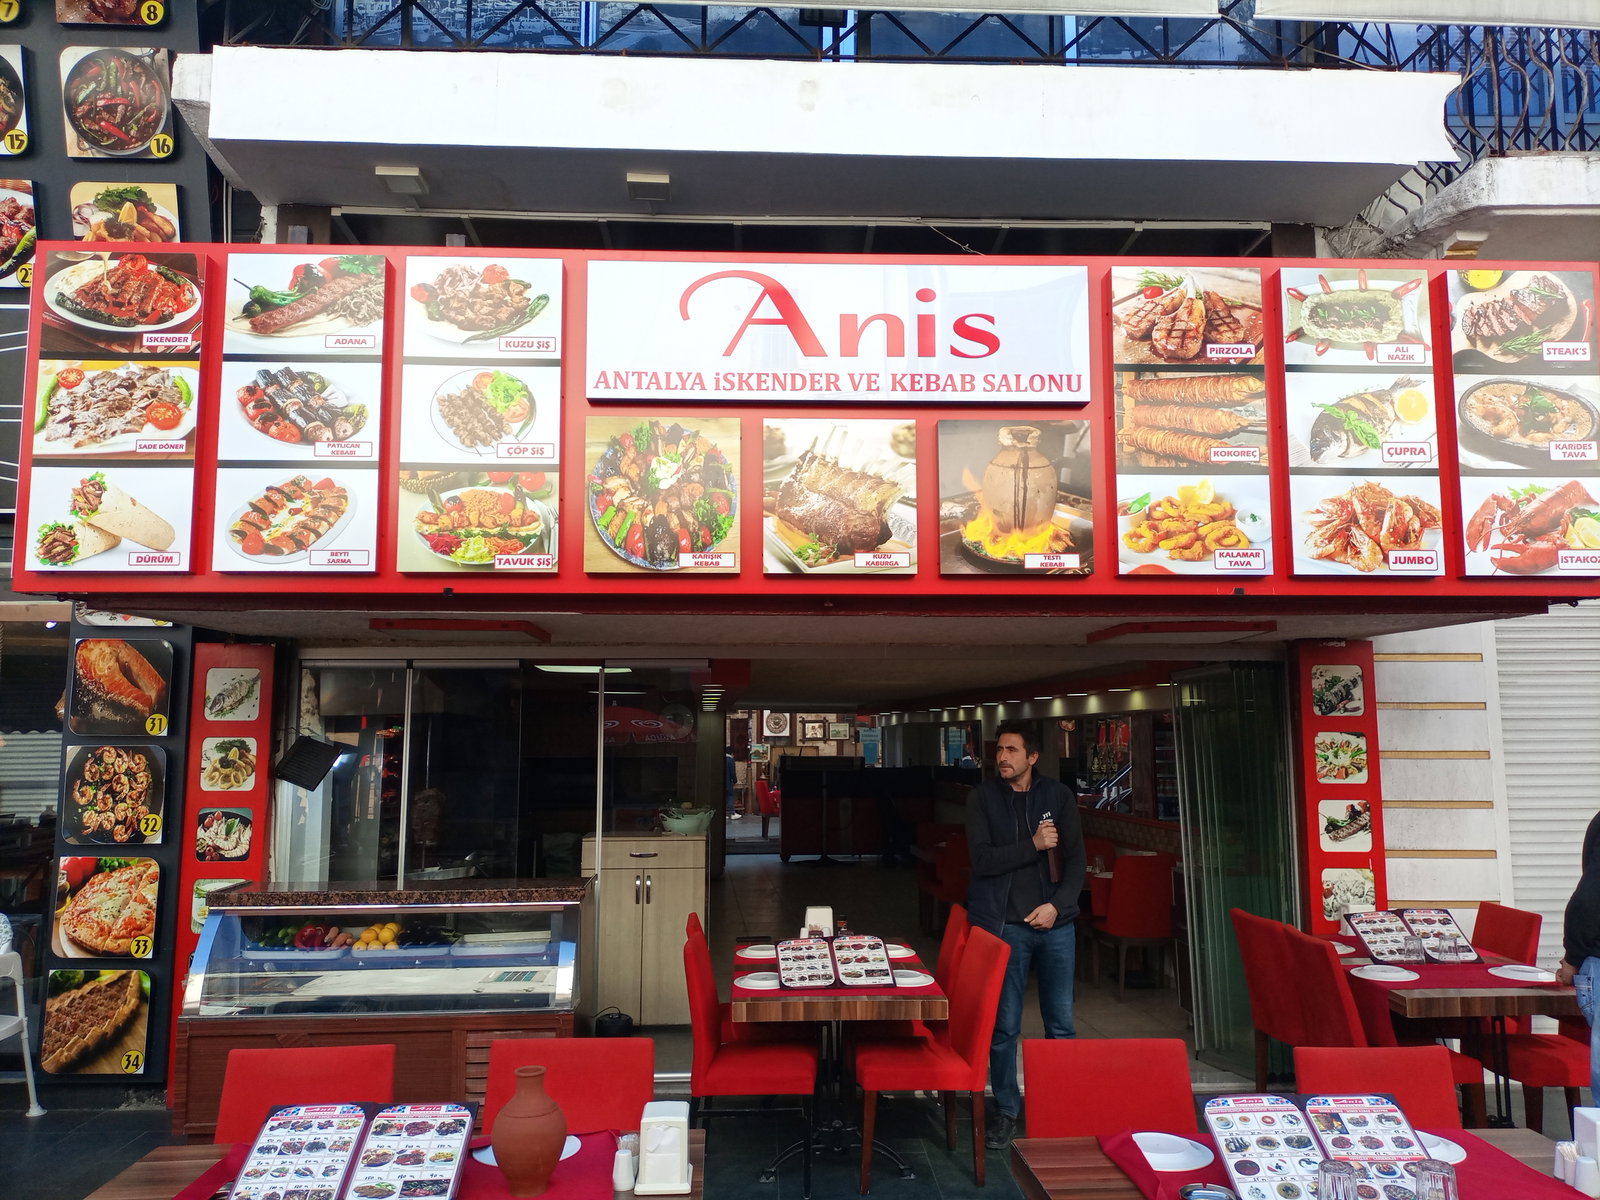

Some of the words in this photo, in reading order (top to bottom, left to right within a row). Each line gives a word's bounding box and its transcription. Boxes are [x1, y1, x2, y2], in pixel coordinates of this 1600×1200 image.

[146, 4, 158, 21] 8
[7, 134, 25, 149] 15
[154, 138, 170, 154] 16
[20, 267, 32, 283] 2
[679, 270, 1000, 359] Anis
[505, 340, 534, 348] KUZU
[593, 370, 707, 391] ANTALYA
[847, 373, 880, 392] VE
[891, 373, 976, 392] KEBAB
[982, 373, 1083, 393] SALONU
[507, 446, 528, 456] ÇÖP
[1213, 450, 1257, 458] KOKOREÇ
[1387, 447, 1426, 457] ÇUPRA
[136, 554, 173, 564] DÜRÜM
[497, 558, 534, 566] TAVUK
[1392, 556, 1434, 565] JUMBO
[150, 717, 163, 732] 31
[143, 817, 158, 832] 32
[134, 939, 148, 954] 33
[124, 1054, 140, 1070] 34
